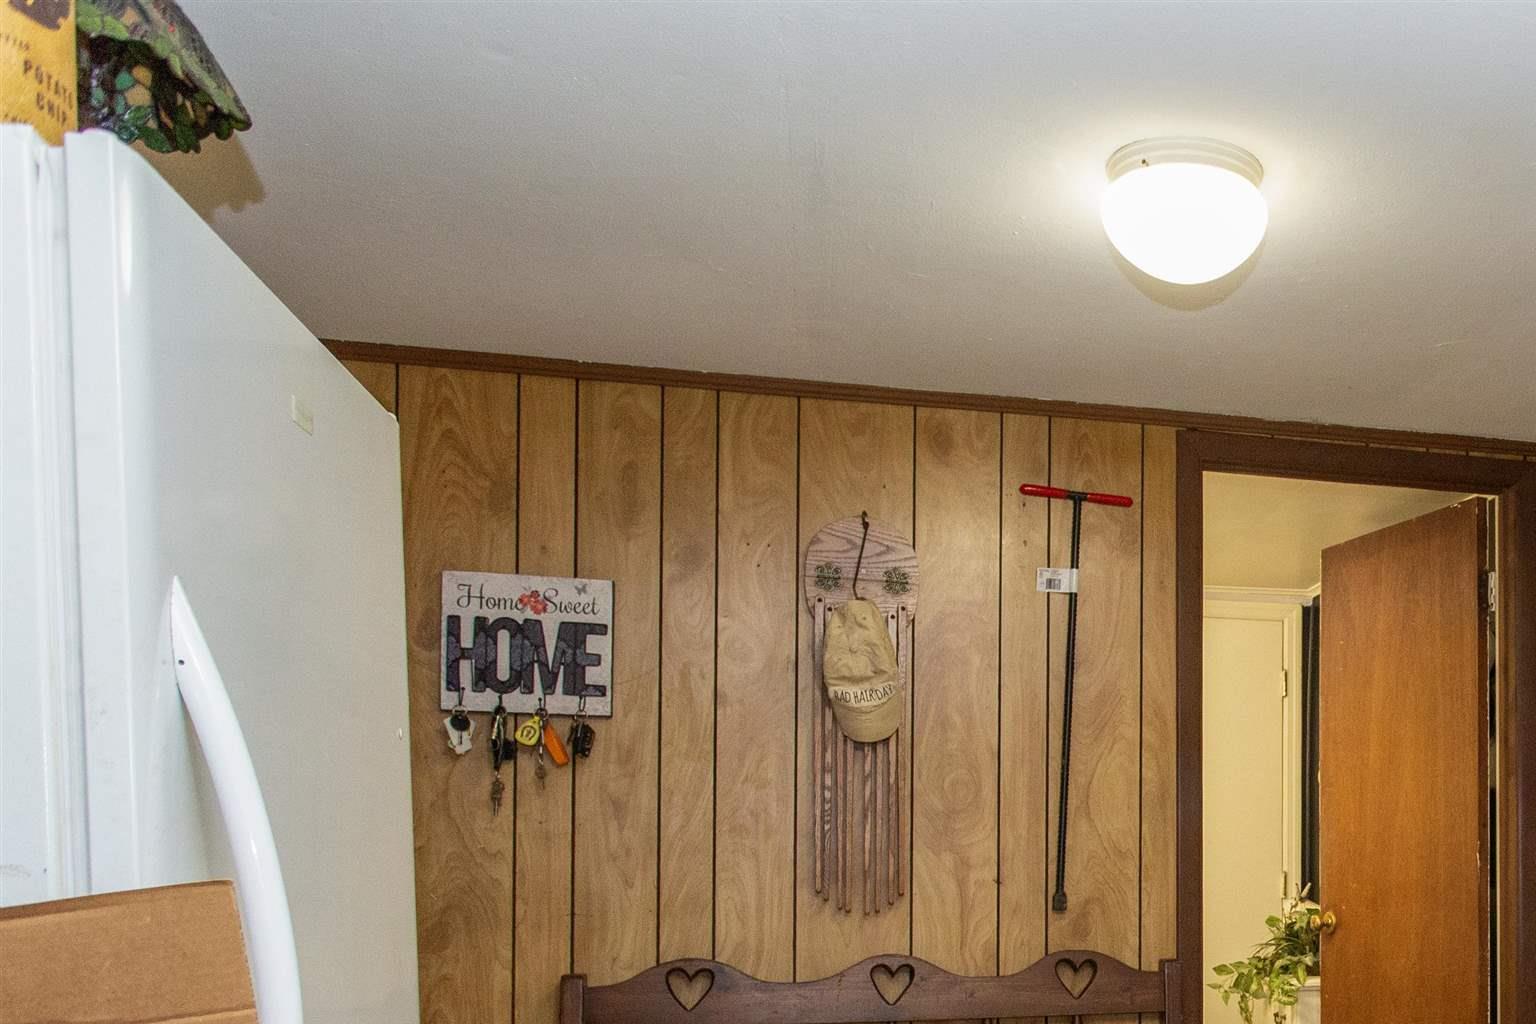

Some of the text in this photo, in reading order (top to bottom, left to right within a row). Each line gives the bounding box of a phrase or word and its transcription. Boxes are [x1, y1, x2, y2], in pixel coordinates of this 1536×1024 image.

[456, 583, 600, 615] Home Sweet
[446, 615, 608, 697] HOME
[833, 683, 894, 704] BAD HAIR DAY
